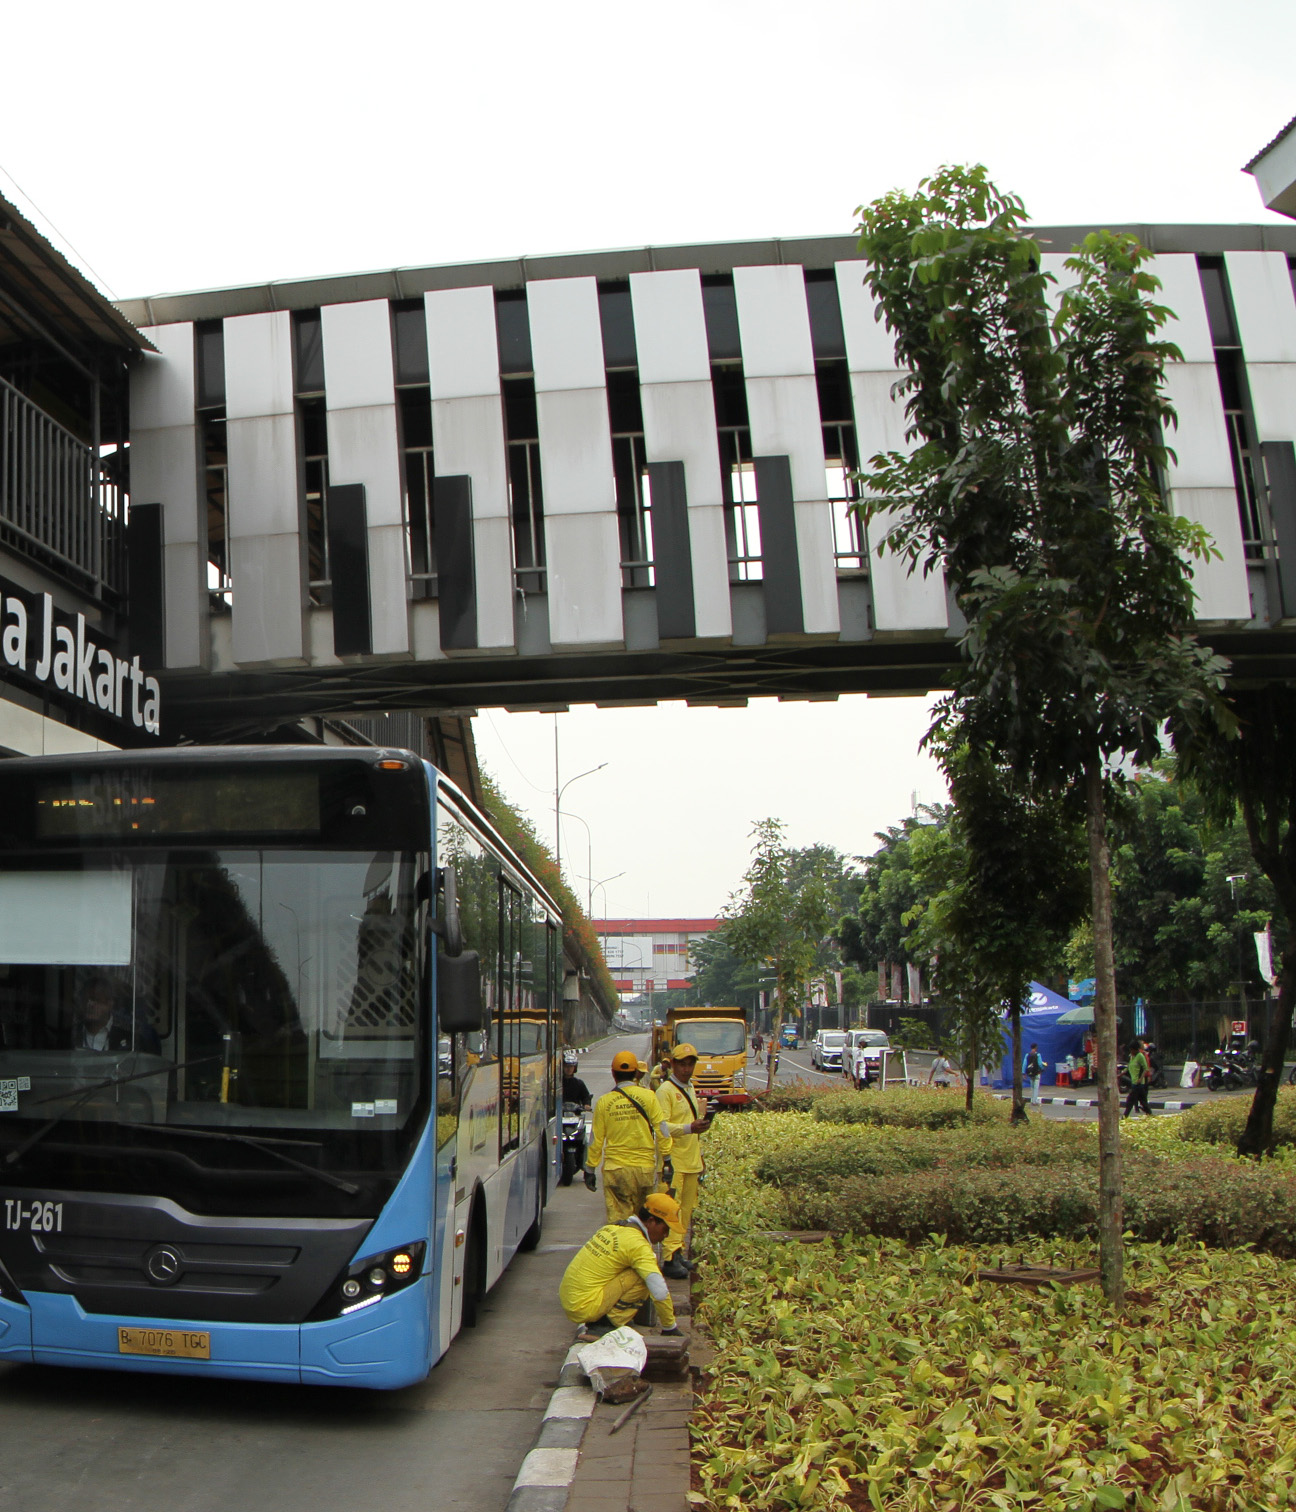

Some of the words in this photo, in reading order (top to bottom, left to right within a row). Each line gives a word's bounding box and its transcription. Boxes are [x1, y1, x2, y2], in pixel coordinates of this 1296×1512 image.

[35, 592, 160, 735] Jakarta
[5, 1199, 63, 1232] TJ-261
[121, 1329, 129, 1344] B
[139, 1330, 173, 1347] 7076
[182, 1333, 207, 1349] TGC
